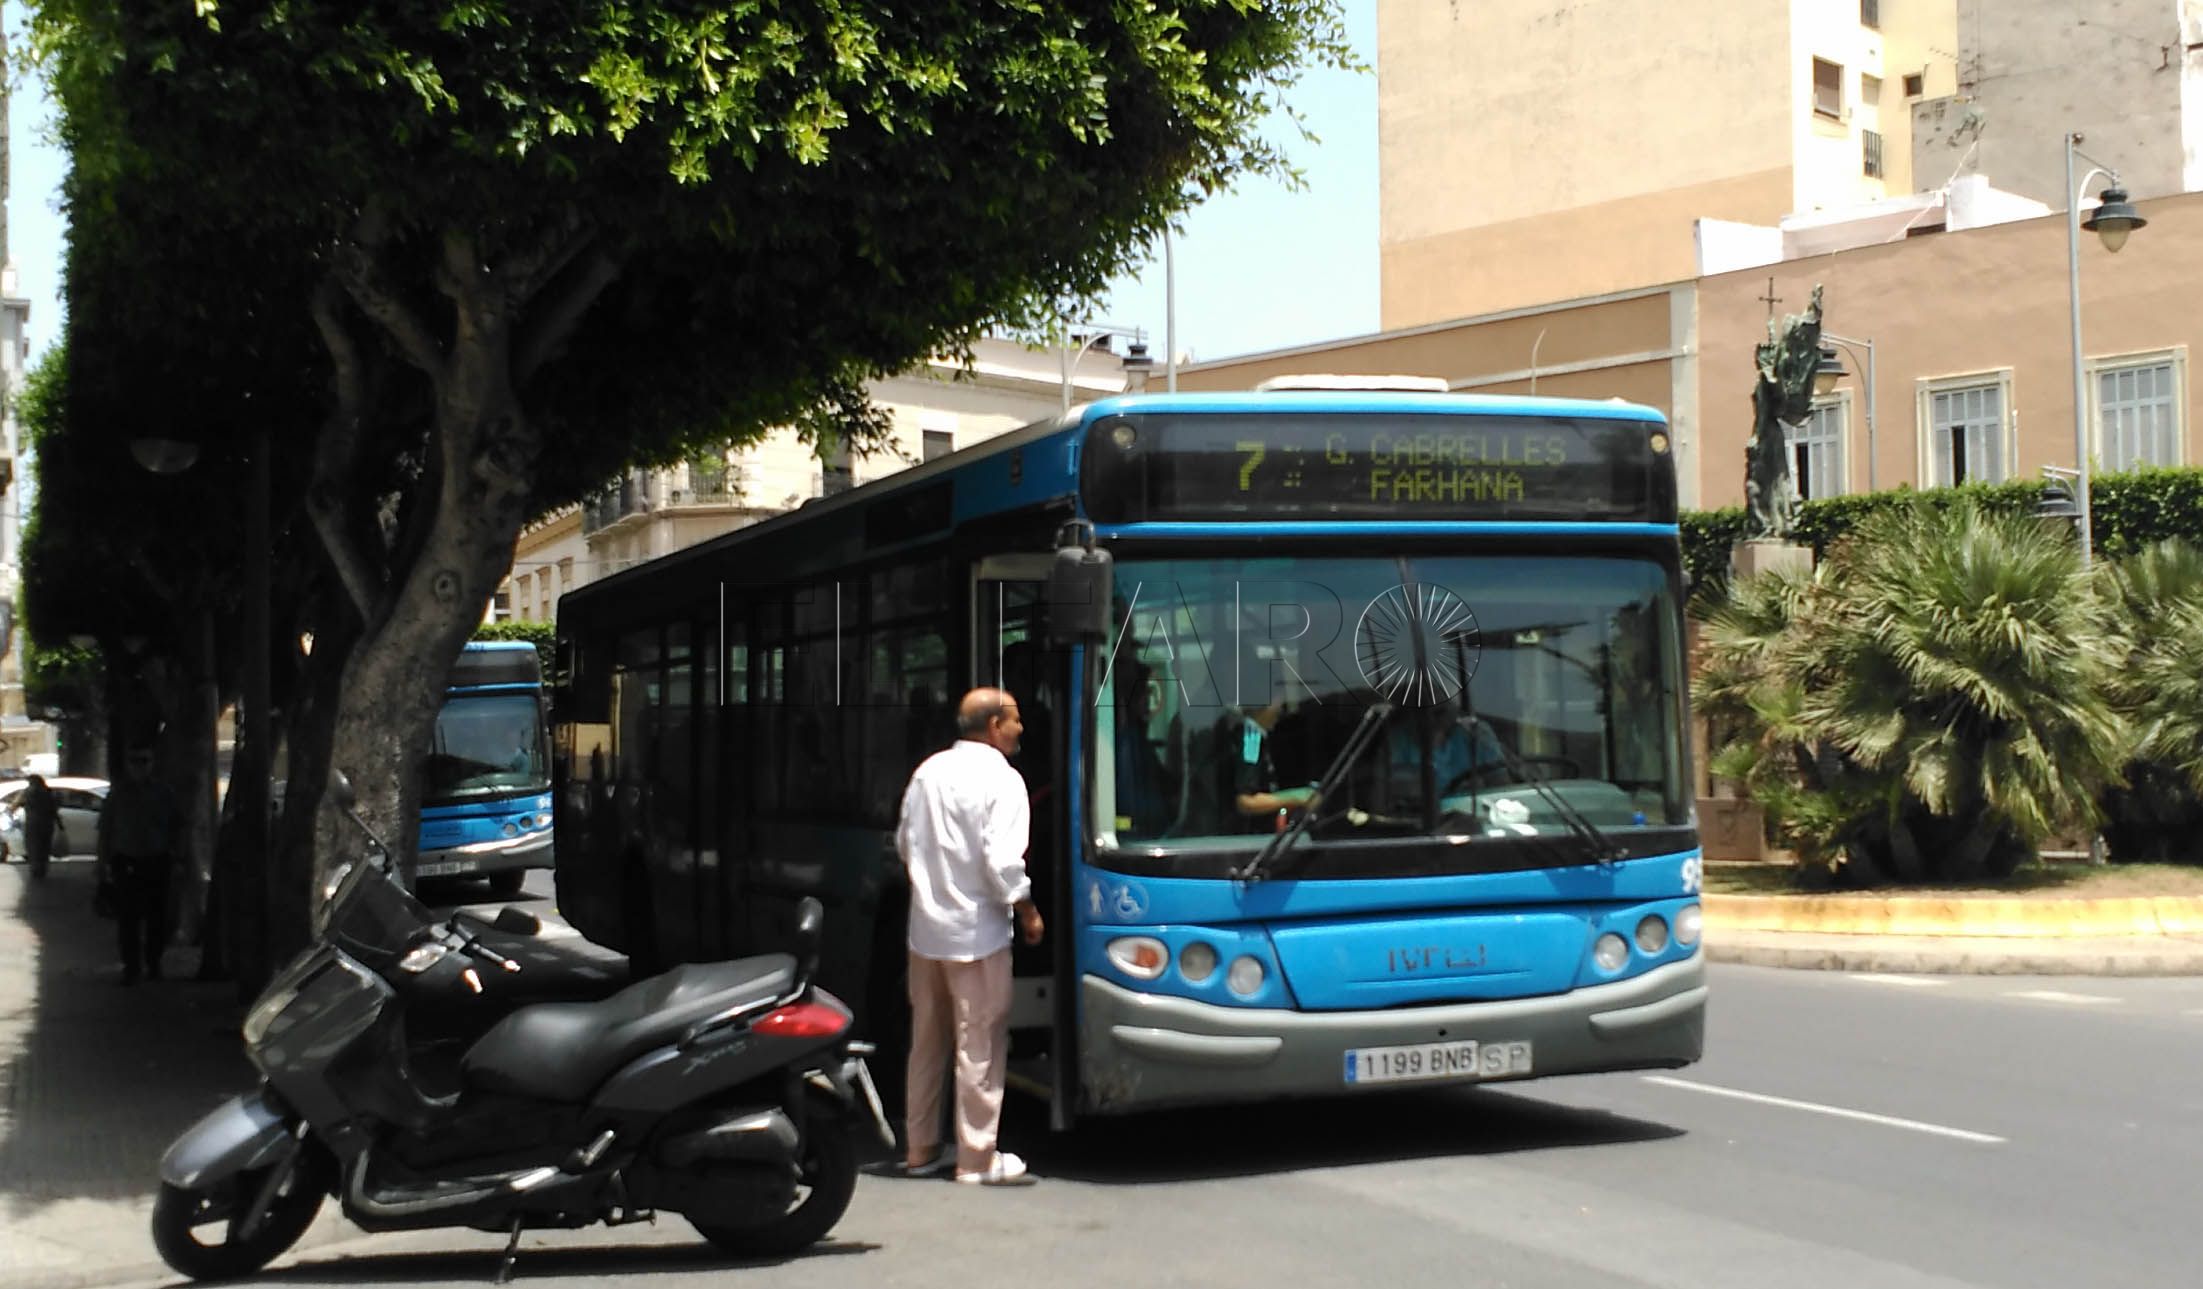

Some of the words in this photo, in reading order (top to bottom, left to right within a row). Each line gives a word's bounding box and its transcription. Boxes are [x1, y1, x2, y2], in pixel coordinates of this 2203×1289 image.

[1234, 440, 1267, 491] 7
[1370, 433, 1567, 467] CABRELLES
[1370, 470, 1525, 501] FARHANA
[1365, 1051, 1422, 1076] 1199
[1430, 1046, 1473, 1072] BNB
